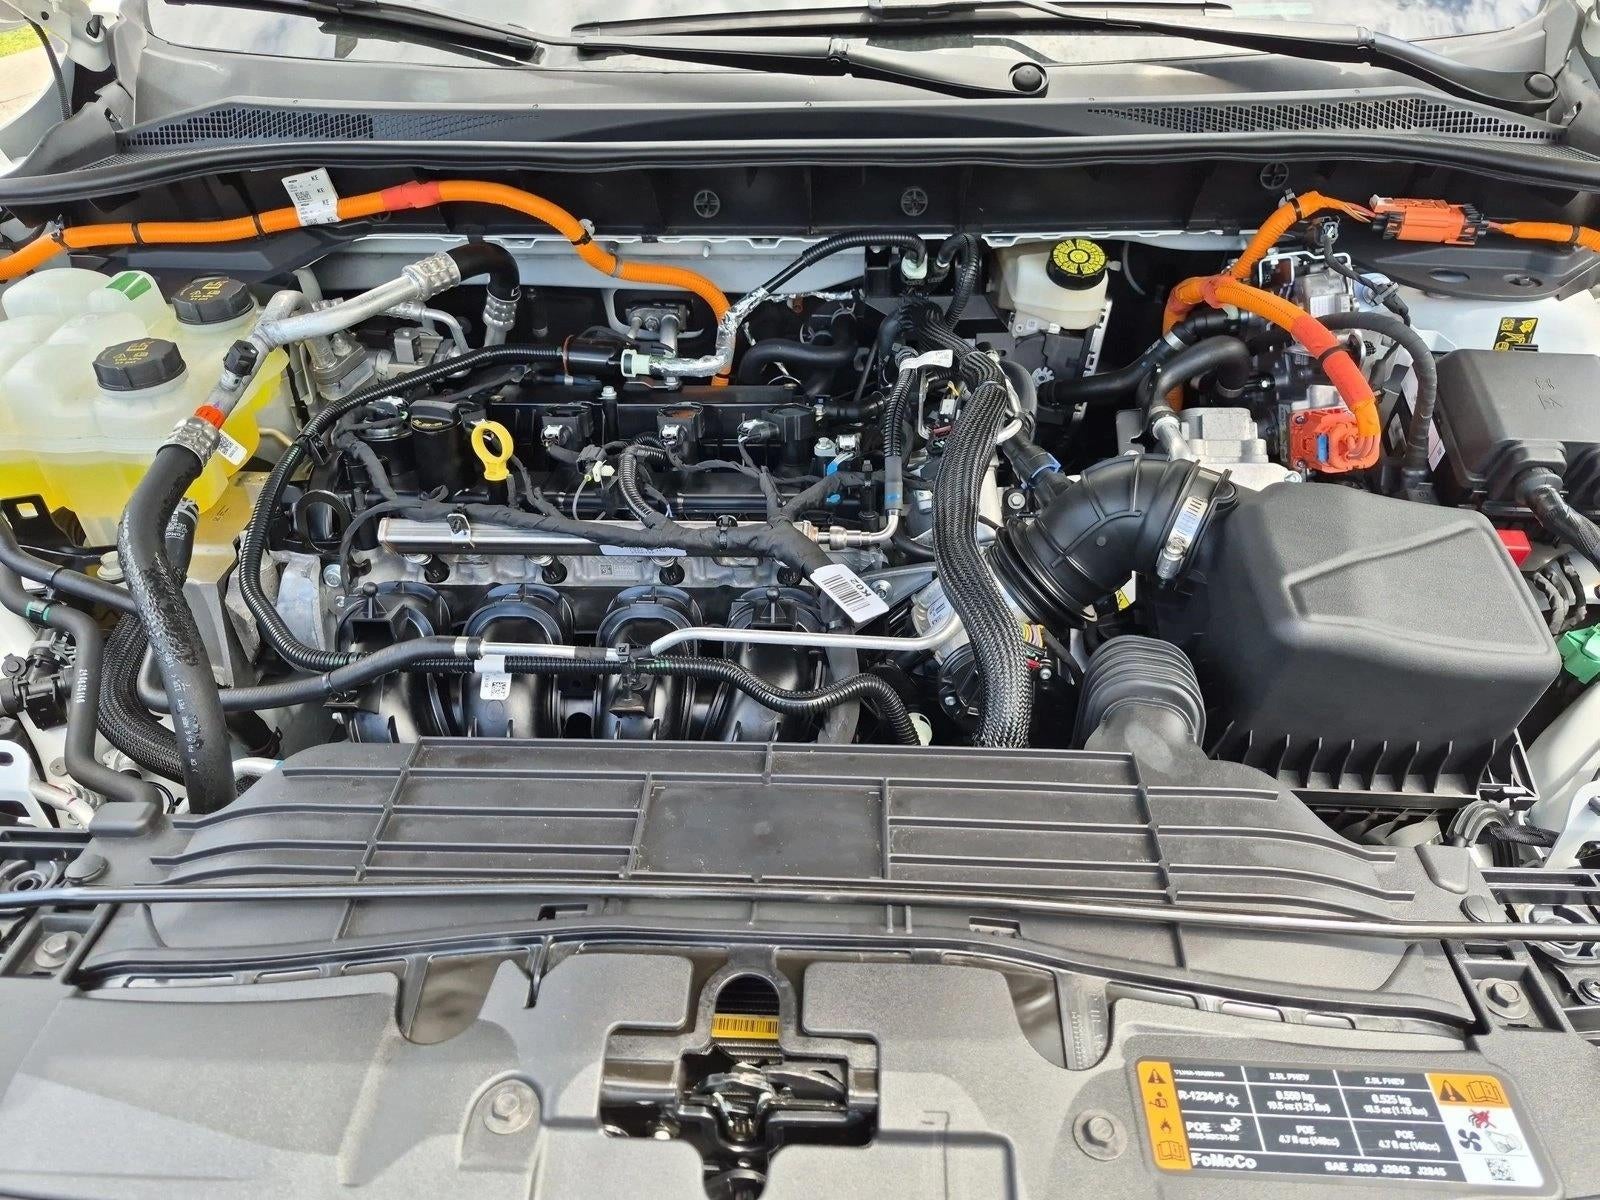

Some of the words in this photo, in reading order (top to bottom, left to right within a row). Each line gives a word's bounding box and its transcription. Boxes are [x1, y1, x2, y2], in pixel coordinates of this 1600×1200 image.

[1186, 1121, 1212, 1132] POE
[1295, 1125, 1316, 1135] POE
[1395, 1130, 1416, 1140] POE
[1191, 1152, 1257, 1169] FoMoCo
[1325, 1161, 1348, 1172] SAE
